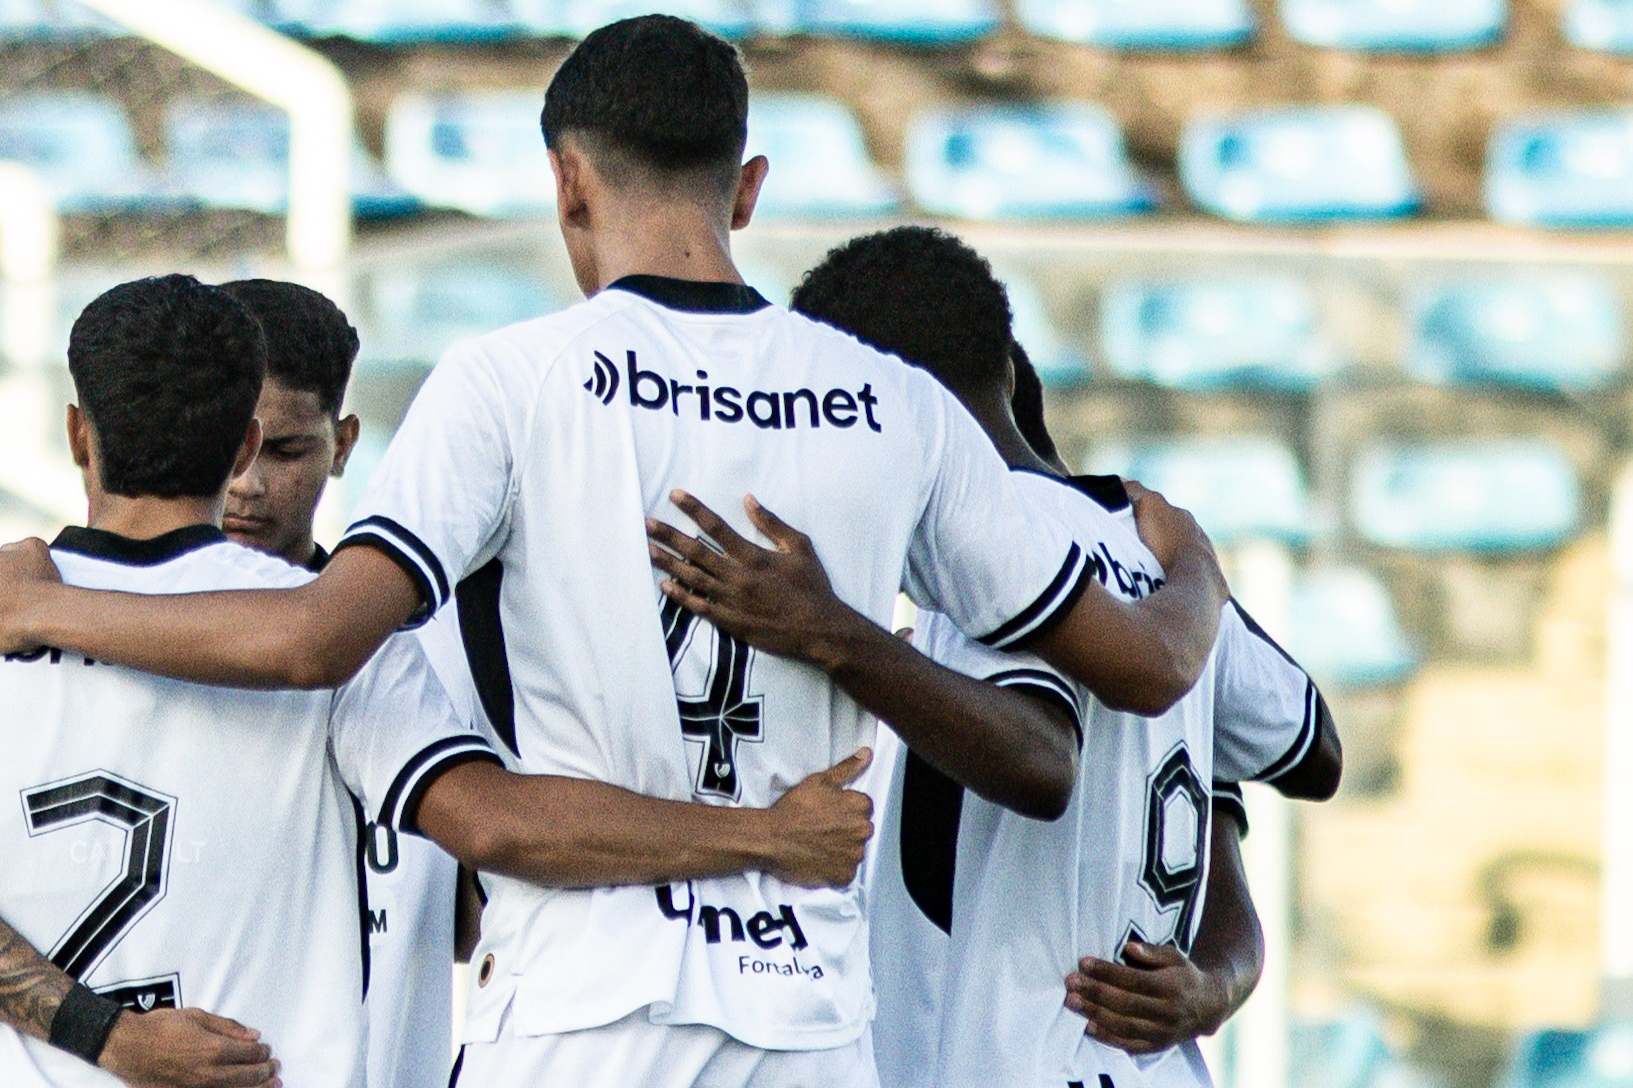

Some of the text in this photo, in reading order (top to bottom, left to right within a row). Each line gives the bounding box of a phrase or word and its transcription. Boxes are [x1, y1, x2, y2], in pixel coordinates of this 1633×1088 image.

[625, 350, 883, 433] brisanet
[19, 767, 184, 1010] 2
[1115, 739, 1213, 967] 9
